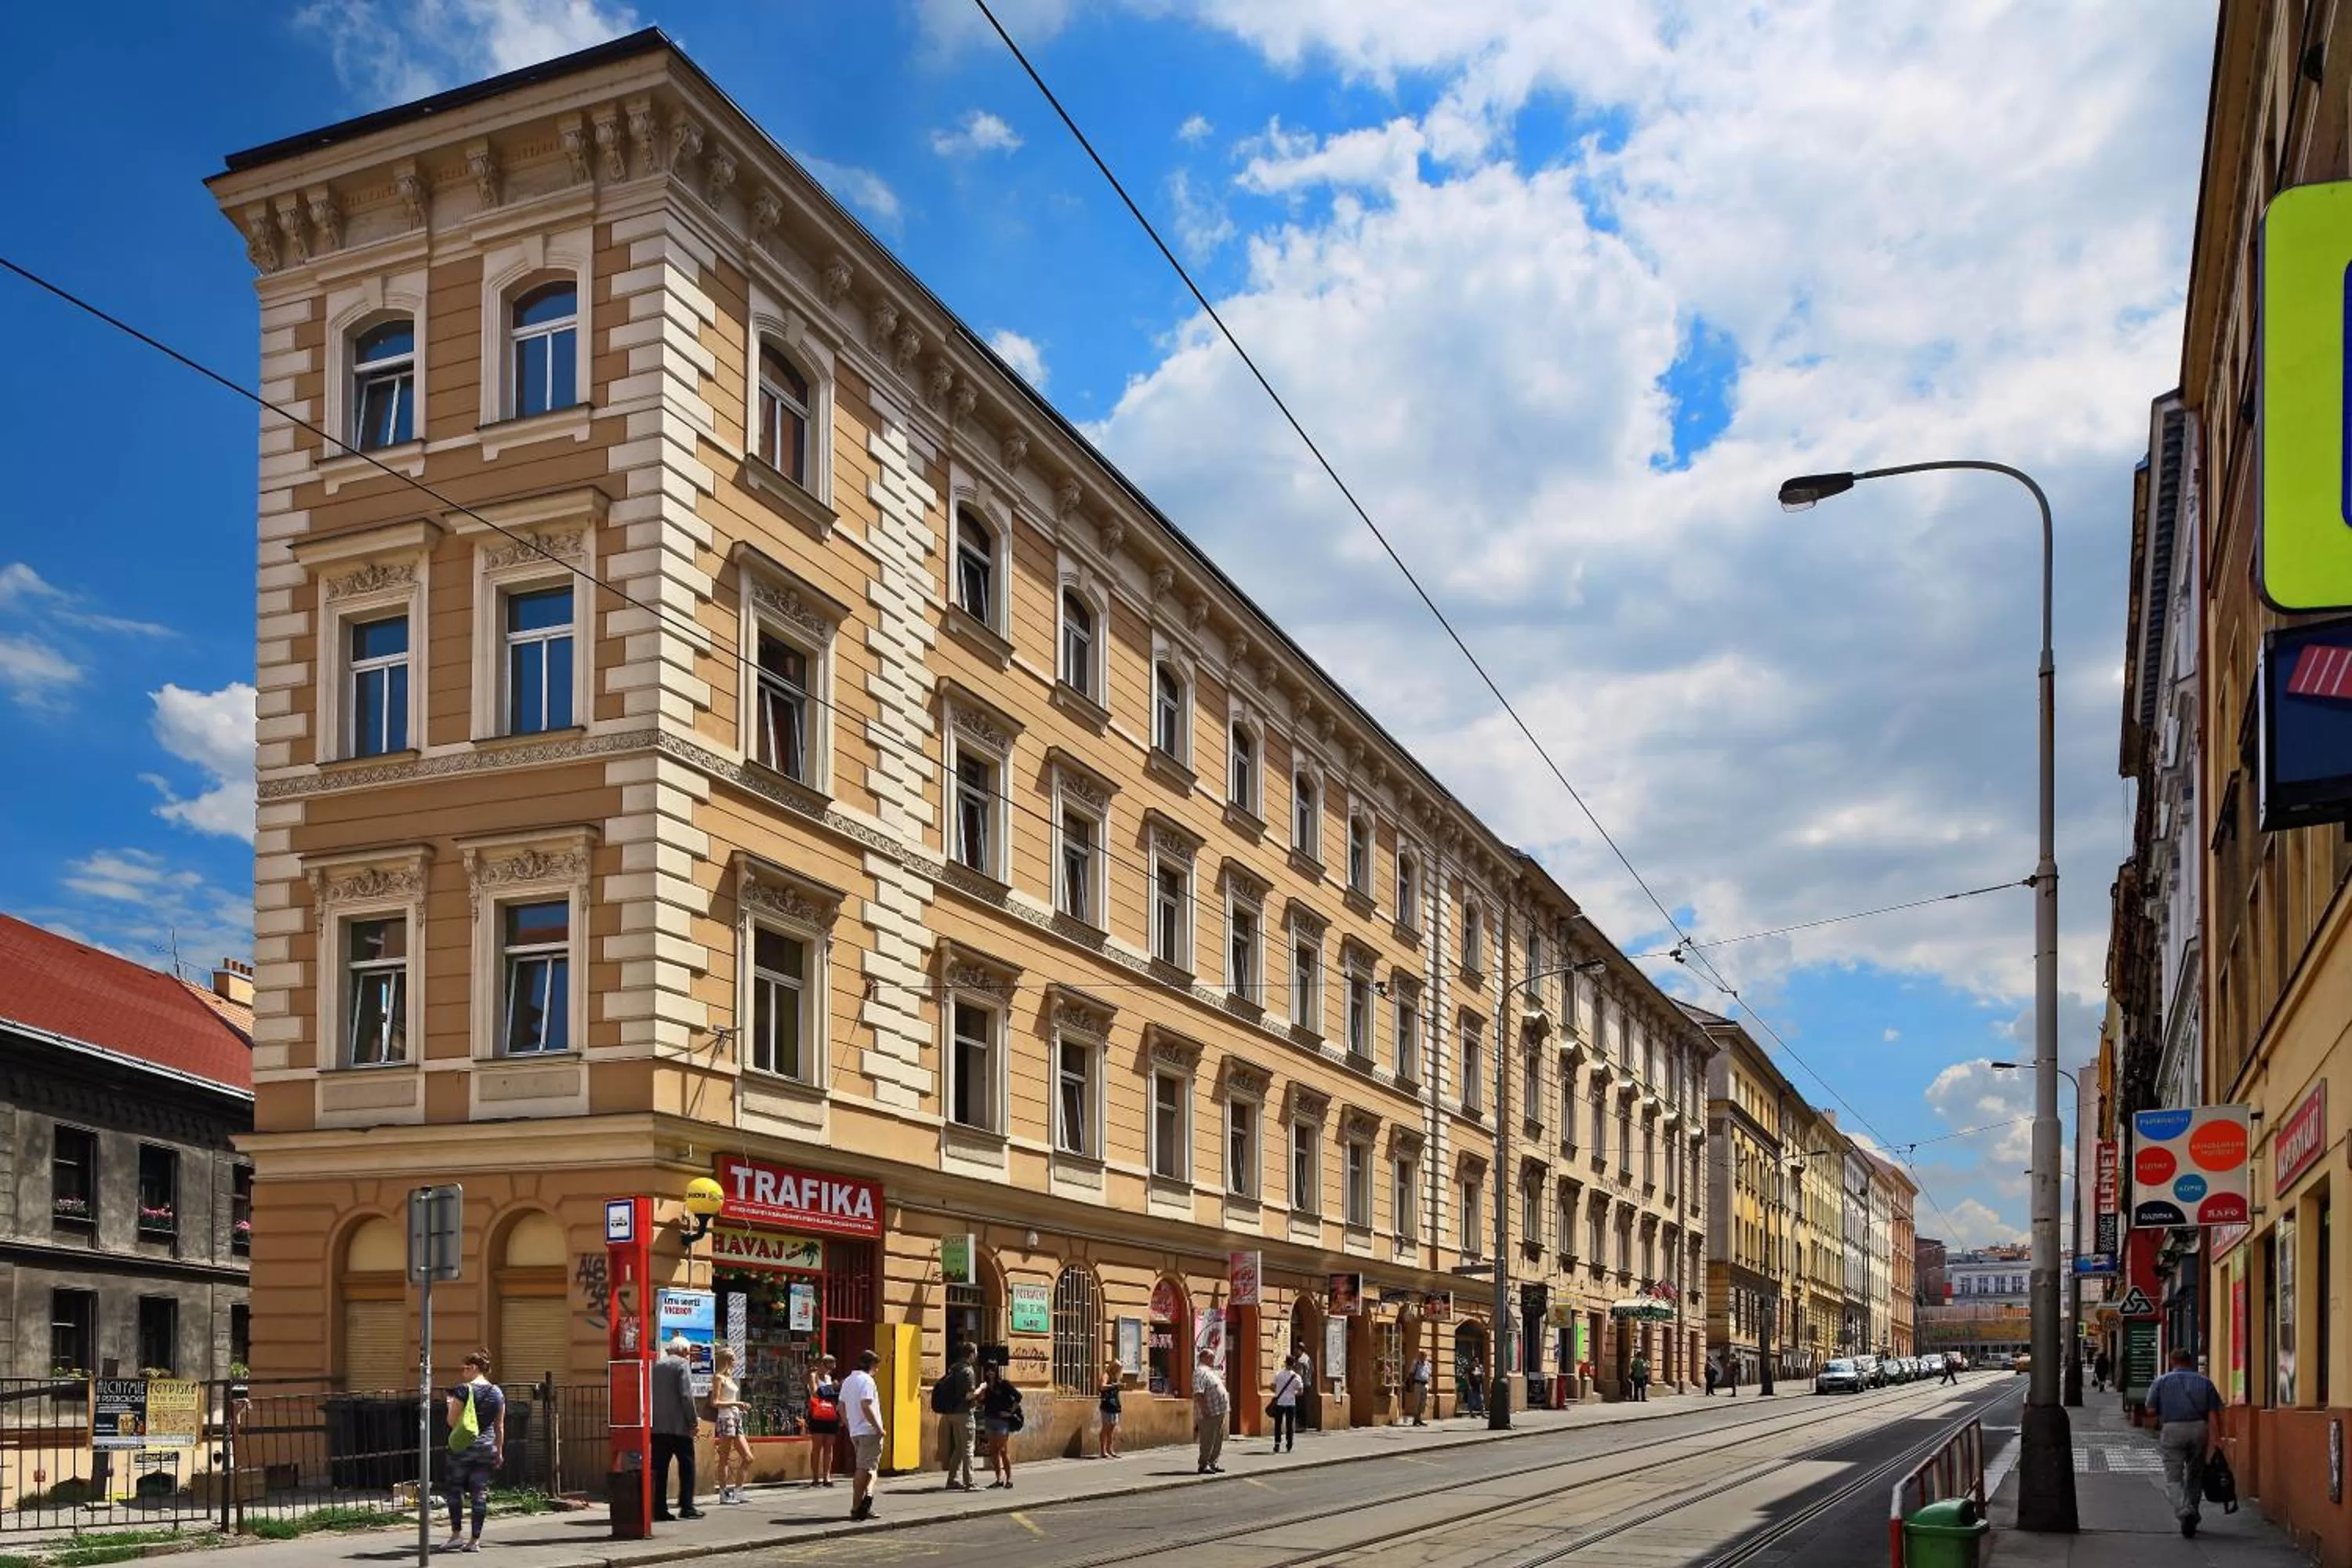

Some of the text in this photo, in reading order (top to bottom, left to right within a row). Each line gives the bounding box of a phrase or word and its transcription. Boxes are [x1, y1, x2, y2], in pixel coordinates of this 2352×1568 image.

[730, 1164, 875, 1220] TRAFIKA
[2100, 1145, 2116, 1214] ELFNET
[712, 1232, 783, 1261] HAVAJ
[96, 1381, 146, 1395] ALCHYMIE
